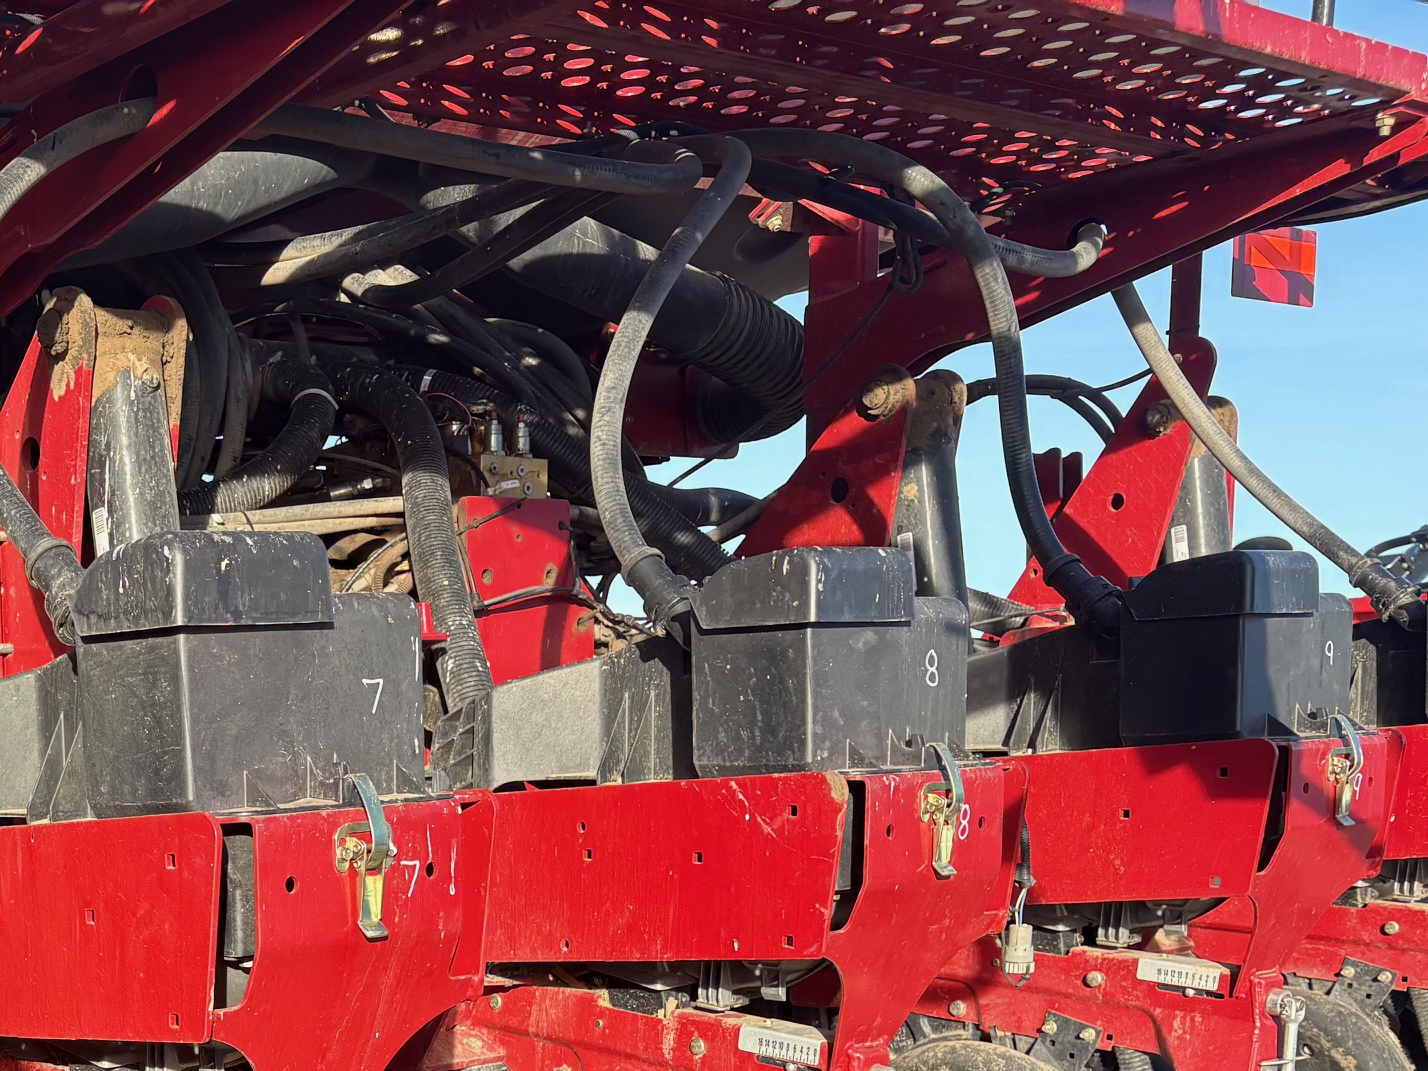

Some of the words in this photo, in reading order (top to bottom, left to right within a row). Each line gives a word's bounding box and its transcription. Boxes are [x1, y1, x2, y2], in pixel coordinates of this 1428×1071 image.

[925, 648, 939, 687] 8
[1325, 639, 1335, 666] 9
[361, 678, 384, 714] 7
[1353, 772, 1363, 801] 9
[957, 803, 971, 840] 8
[400, 860, 420, 898] 7
